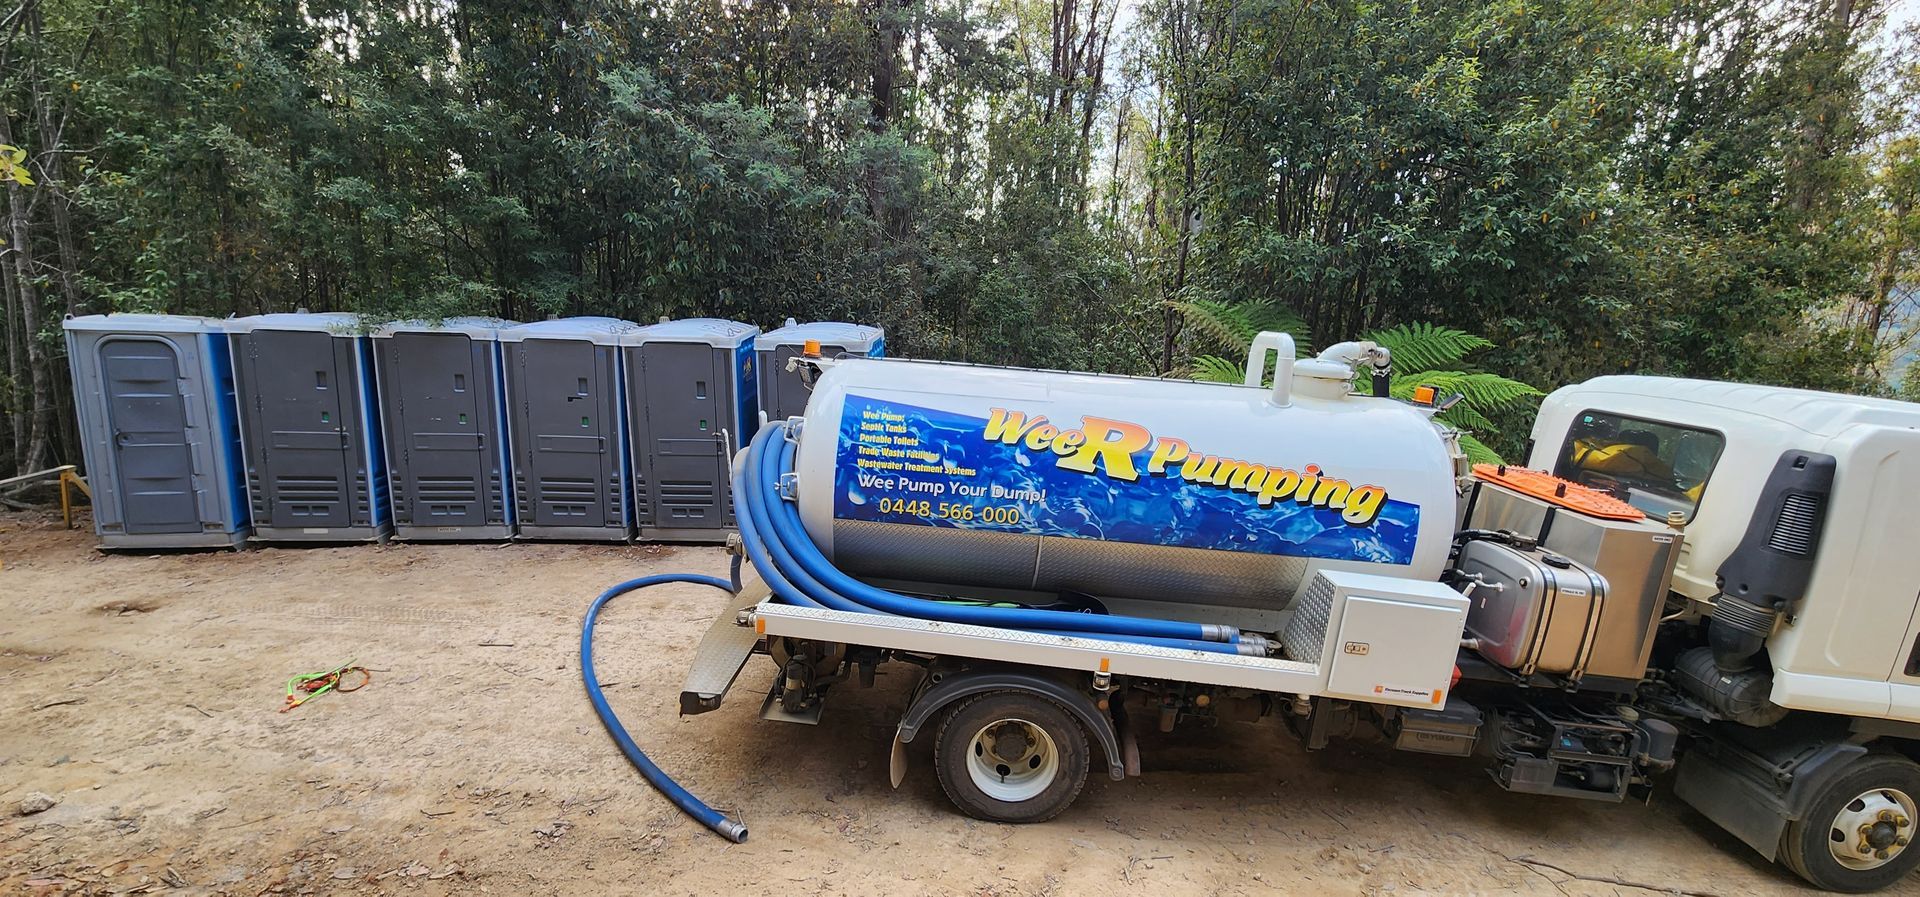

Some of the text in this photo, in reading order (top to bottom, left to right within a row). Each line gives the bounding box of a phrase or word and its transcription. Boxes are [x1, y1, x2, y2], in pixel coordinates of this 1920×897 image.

[863, 411, 880, 420] Wee
[861, 421, 907, 434] Septic Tanks
[860, 433, 919, 446] Portable Toilets
[858, 445, 940, 461] Trade Waste Facilities
[857, 458, 977, 477] Wastewater Treatment Systems
[1147, 436, 1388, 524] Pumping
[857, 473, 1047, 505] Wee Pump Your Dump!
[879, 497, 1020, 525] 0448 566 000
